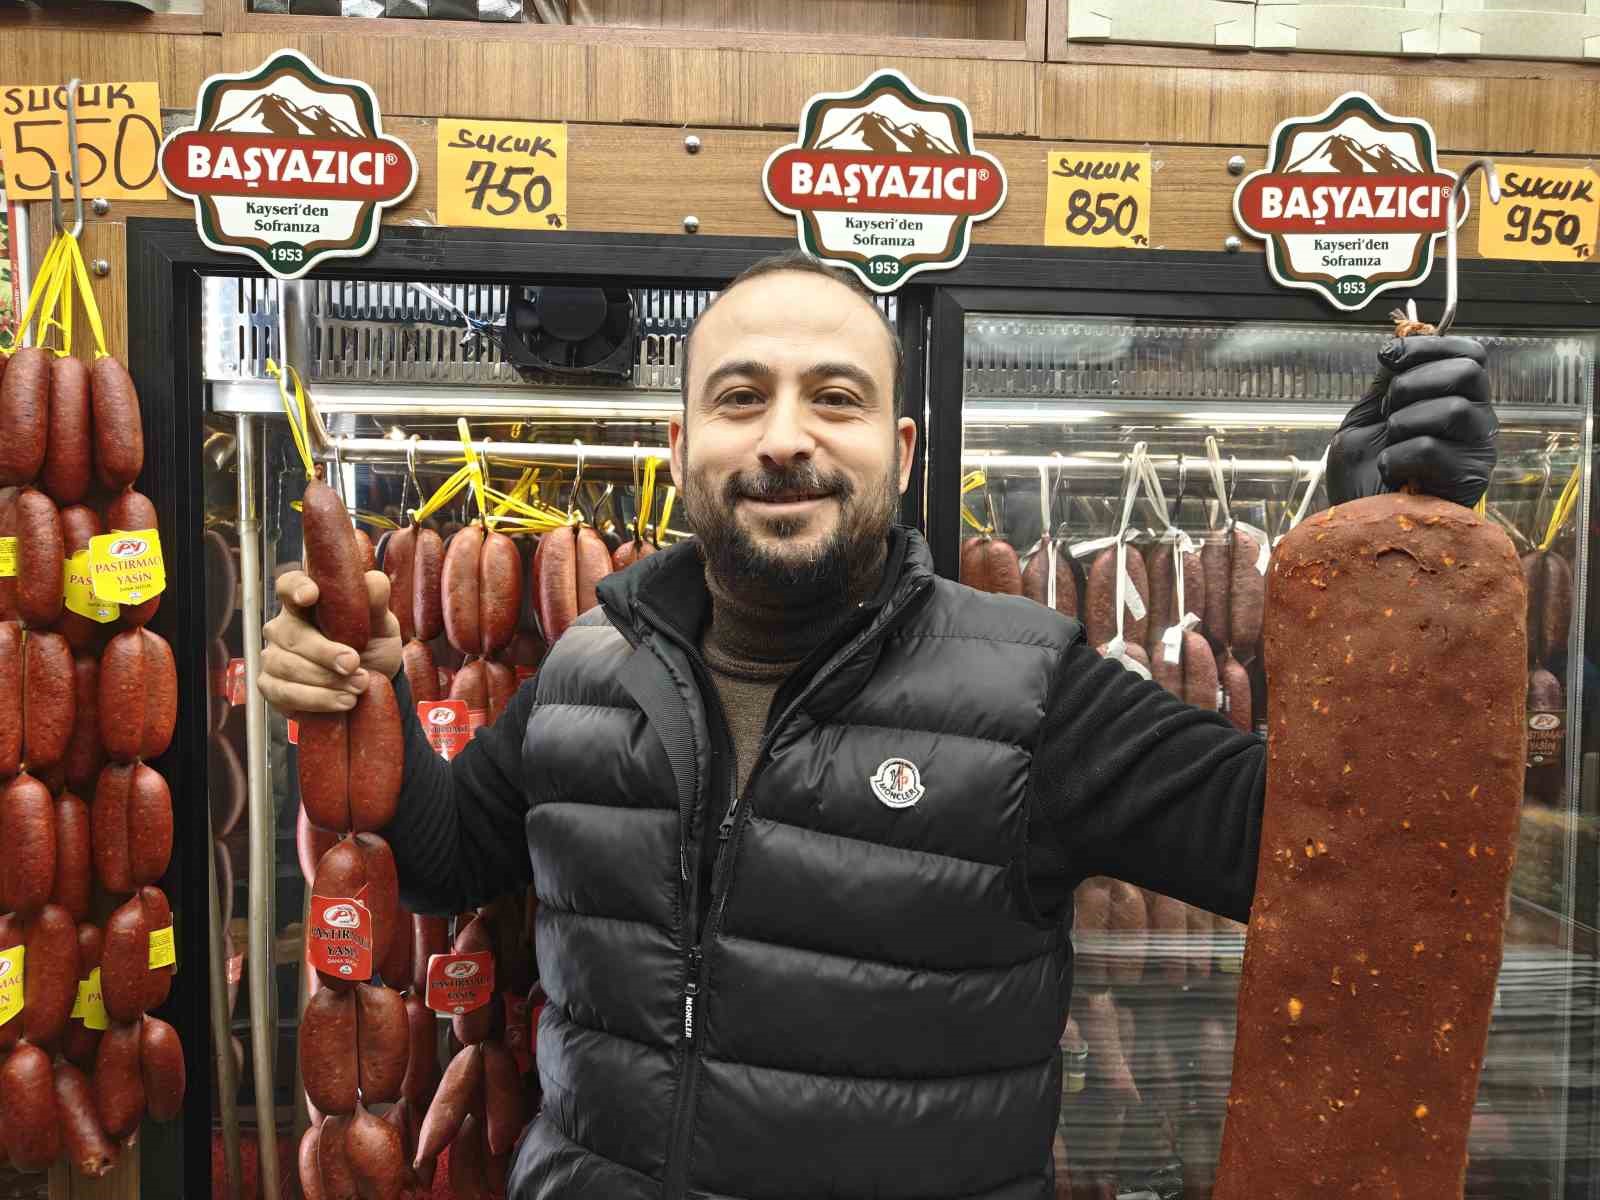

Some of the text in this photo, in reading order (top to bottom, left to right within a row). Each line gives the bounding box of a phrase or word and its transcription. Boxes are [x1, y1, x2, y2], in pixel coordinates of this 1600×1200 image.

[4, 84, 135, 115] SUCUK
[448, 129, 557, 158] SUCUK
[14, 114, 160, 191] 550
[1052, 158, 1140, 182] SUCUK
[465, 160, 552, 216] 750
[1500, 172, 1594, 202] SUCUK
[246, 202, 329, 218] Kayseri'den
[1065, 189, 1138, 236] 850
[254, 219, 320, 233] Sofranıza
[845, 217, 923, 232] Kayseri'den
[1503, 204, 1581, 246] 950
[853, 234, 915, 247] Sofranıza
[1314, 238, 1389, 254] Kayseri'den
[271, 248, 303, 262] 1953
[1321, 255, 1381, 267] Sofranıza
[868, 261, 899, 275] 1953
[1336, 281, 1366, 295] 1953
[879, 783, 917, 800] MONCLER
[685, 995, 693, 1038] MONCLER
